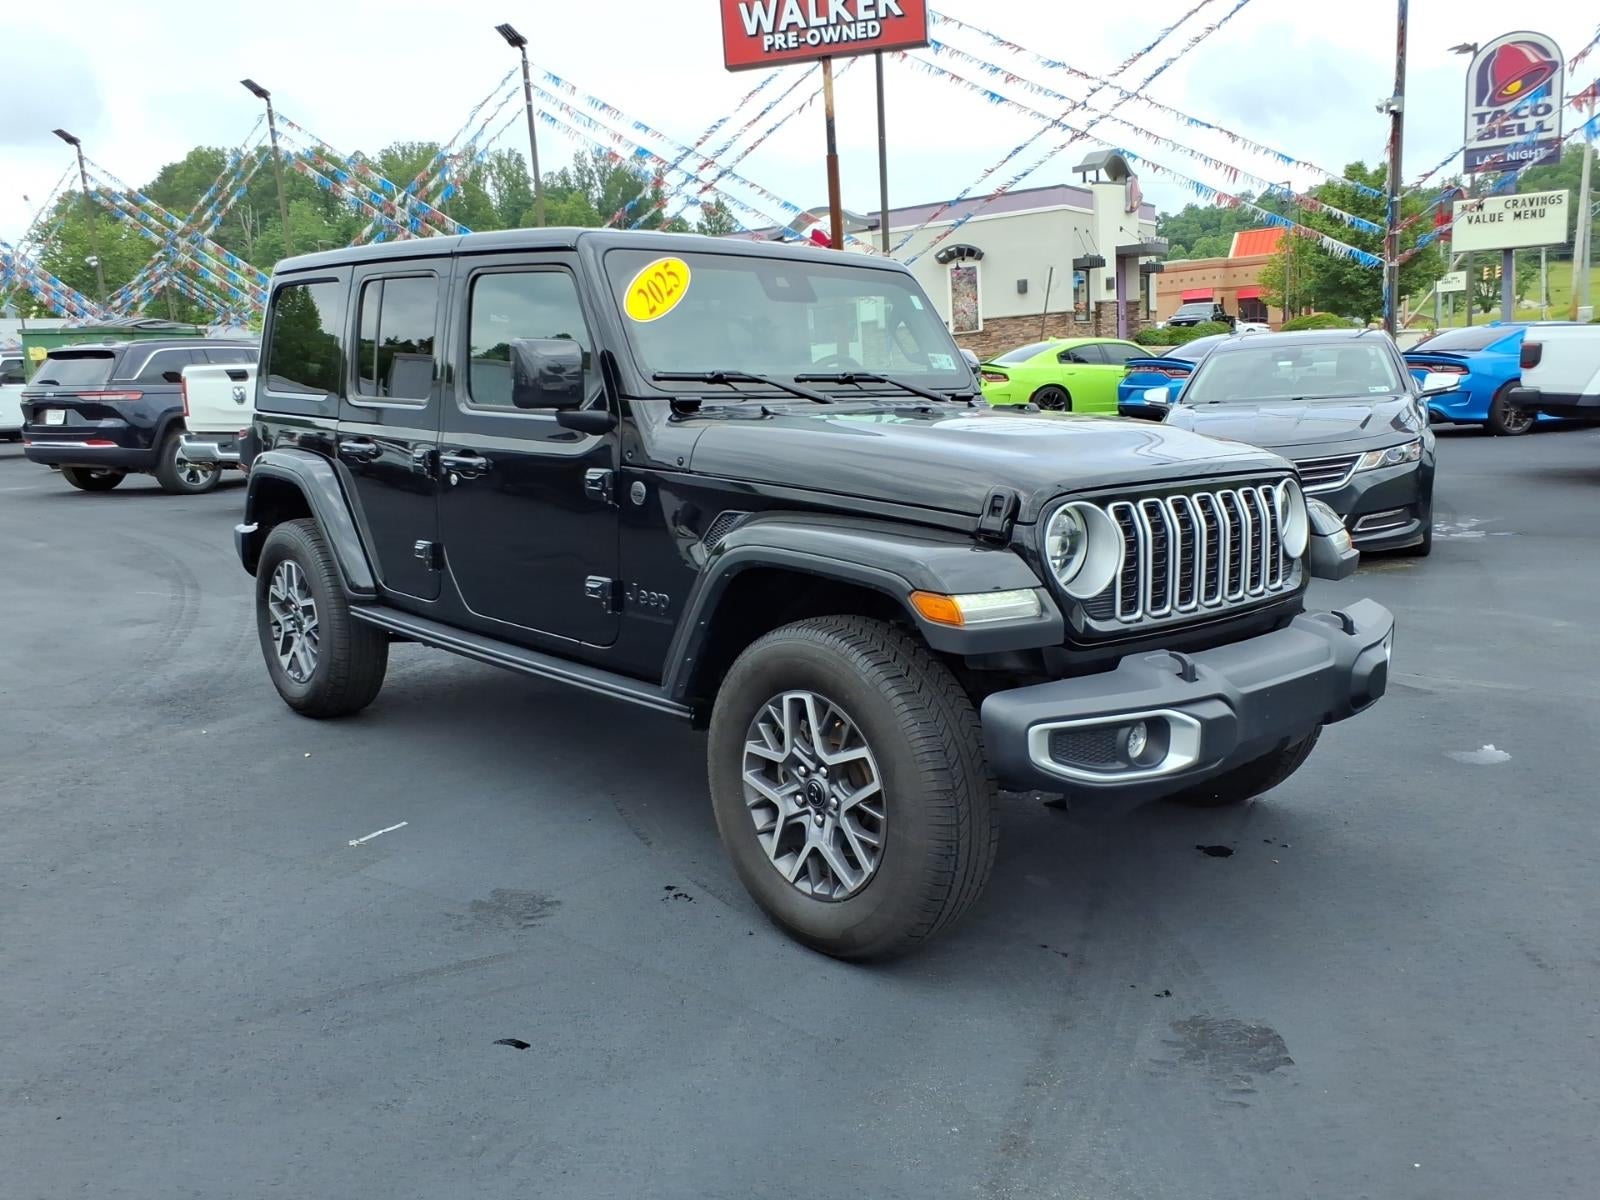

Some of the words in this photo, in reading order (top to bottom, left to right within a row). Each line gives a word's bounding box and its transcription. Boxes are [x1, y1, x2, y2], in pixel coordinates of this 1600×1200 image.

[763, 21, 881, 51] PRE-OWNED
[1472, 103, 1552, 126] TACO
[1477, 120, 1553, 141] BELL
[1504, 194, 1563, 209] CRAVINGS
[1467, 212, 1504, 225] VALUE
[1513, 208, 1546, 220] MENU
[637, 262, 680, 315] 2025
[625, 582, 670, 616] Jeep
